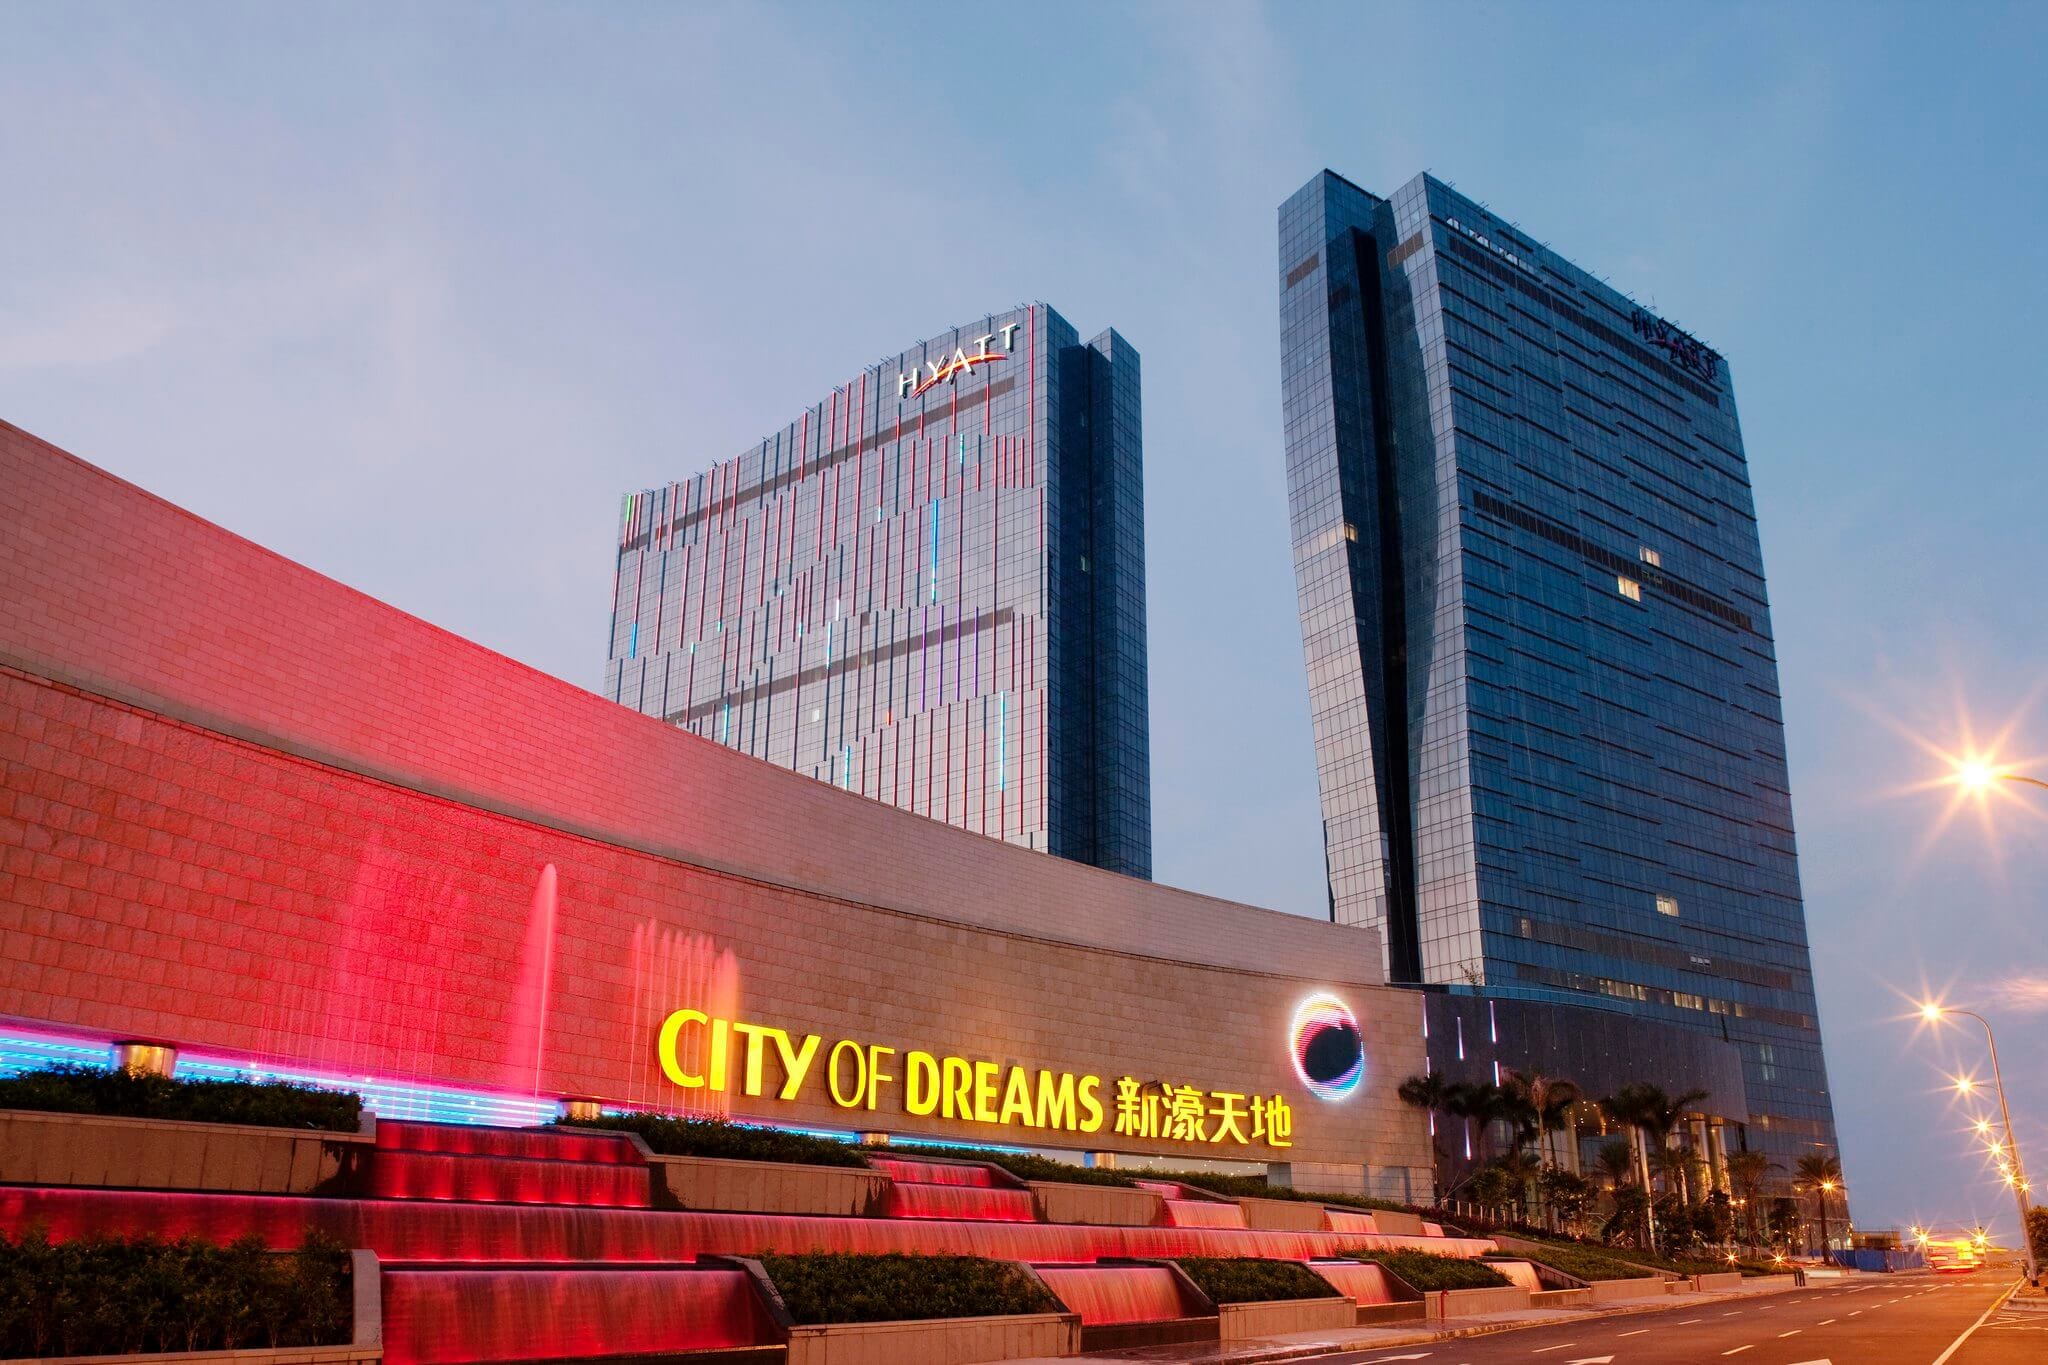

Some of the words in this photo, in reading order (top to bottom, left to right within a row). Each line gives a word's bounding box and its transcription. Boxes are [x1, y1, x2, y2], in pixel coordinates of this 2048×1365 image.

[899, 323, 1019, 397] HYATT
[658, 1008, 822, 1100] CITY
[828, 1040, 895, 1111] OF
[905, 1051, 1103, 1133] DREAMS
[1114, 1076, 1292, 1147] 新濠天地
